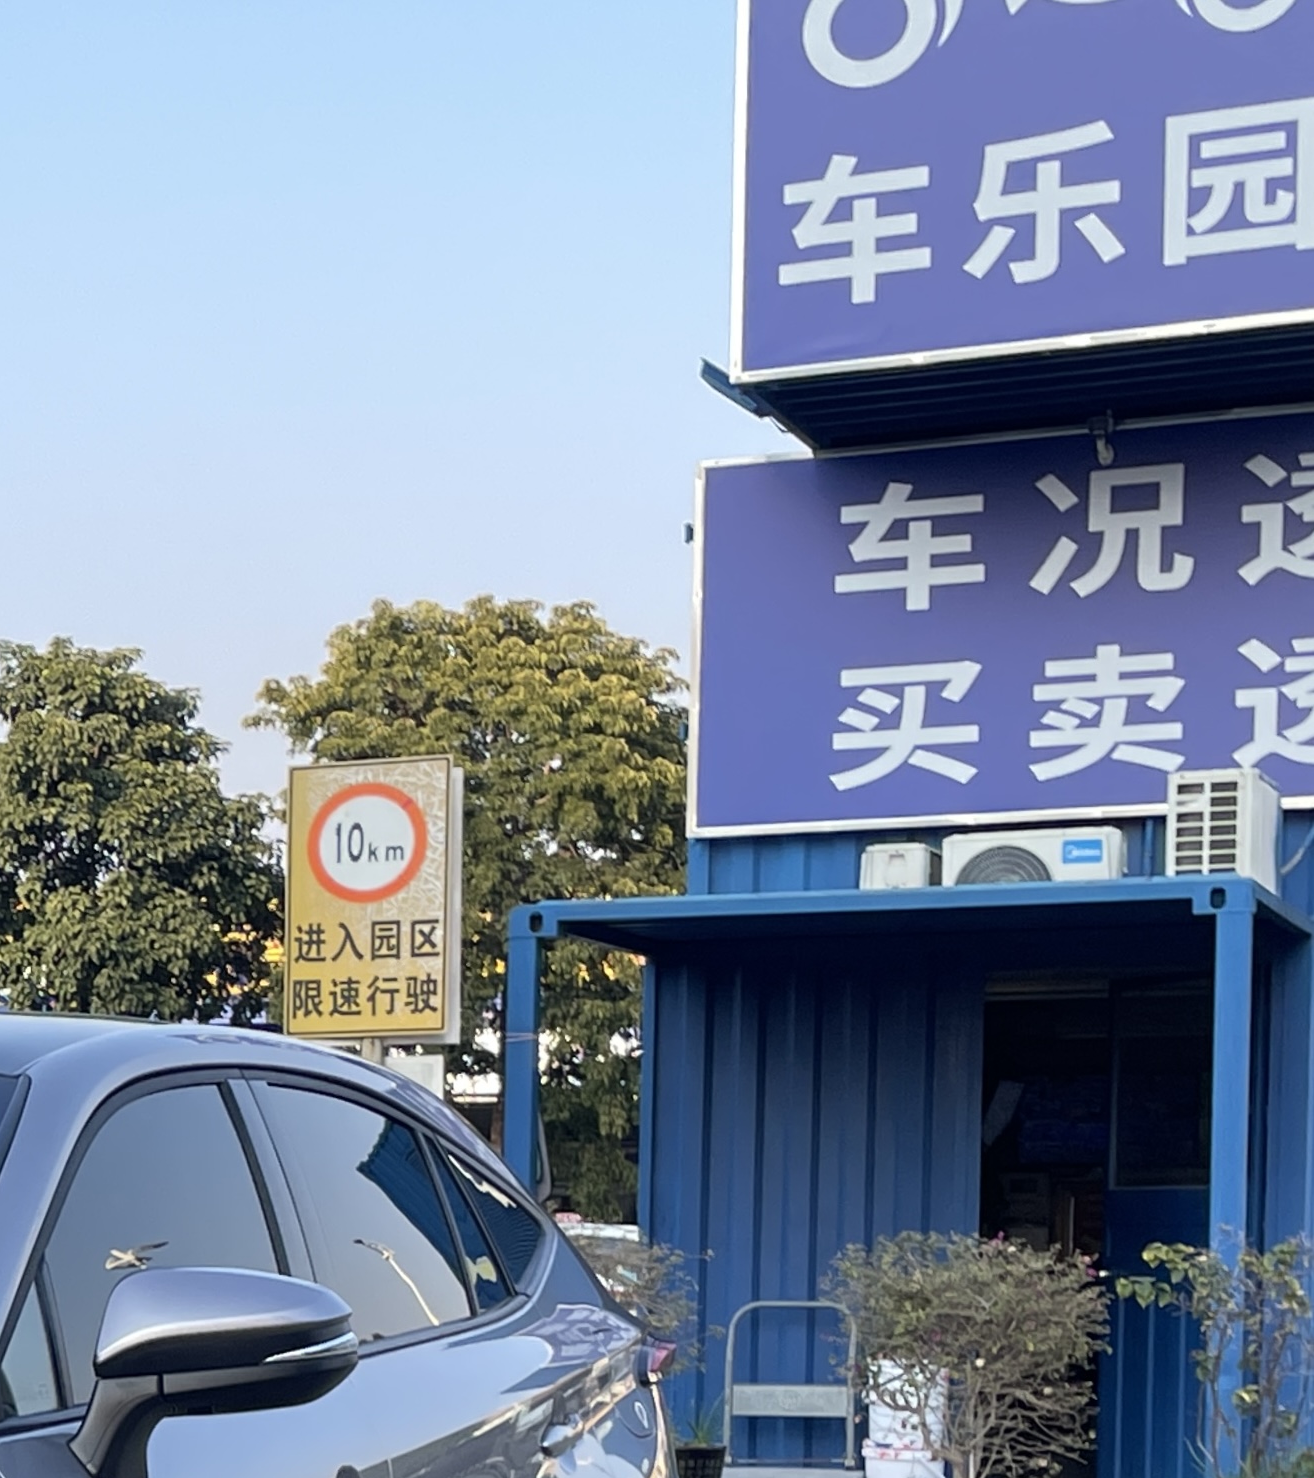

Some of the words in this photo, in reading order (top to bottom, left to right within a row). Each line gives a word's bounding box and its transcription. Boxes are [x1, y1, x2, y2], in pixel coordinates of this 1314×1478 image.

[779, 97, 1314, 304] 车乐园
[293, 919, 441, 963] 进入园区
[292, 972, 439, 1018] 限速行驶
